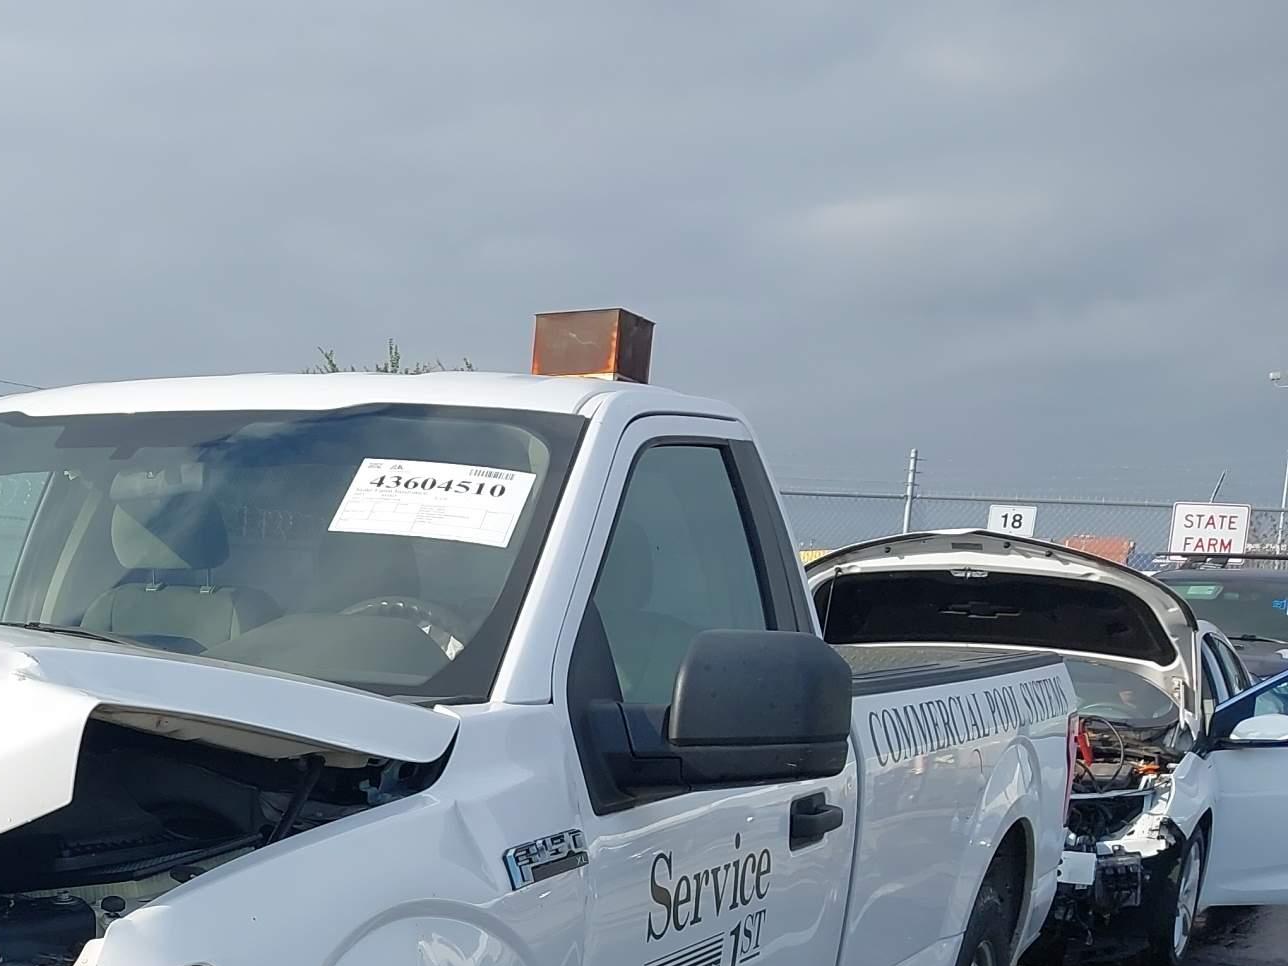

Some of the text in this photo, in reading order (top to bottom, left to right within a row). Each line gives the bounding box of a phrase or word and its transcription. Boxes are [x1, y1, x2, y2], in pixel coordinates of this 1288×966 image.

[369, 474, 506, 498] 43604510
[1000, 513, 1024, 529] 18
[1183, 513, 1238, 531] STATE
[1183, 537, 1232, 553] FARM
[868, 675, 1069, 767] COMMERCIAL POOL SYSTEMS
[576, 854, 587, 864] XL
[646, 831, 771, 944] Service
